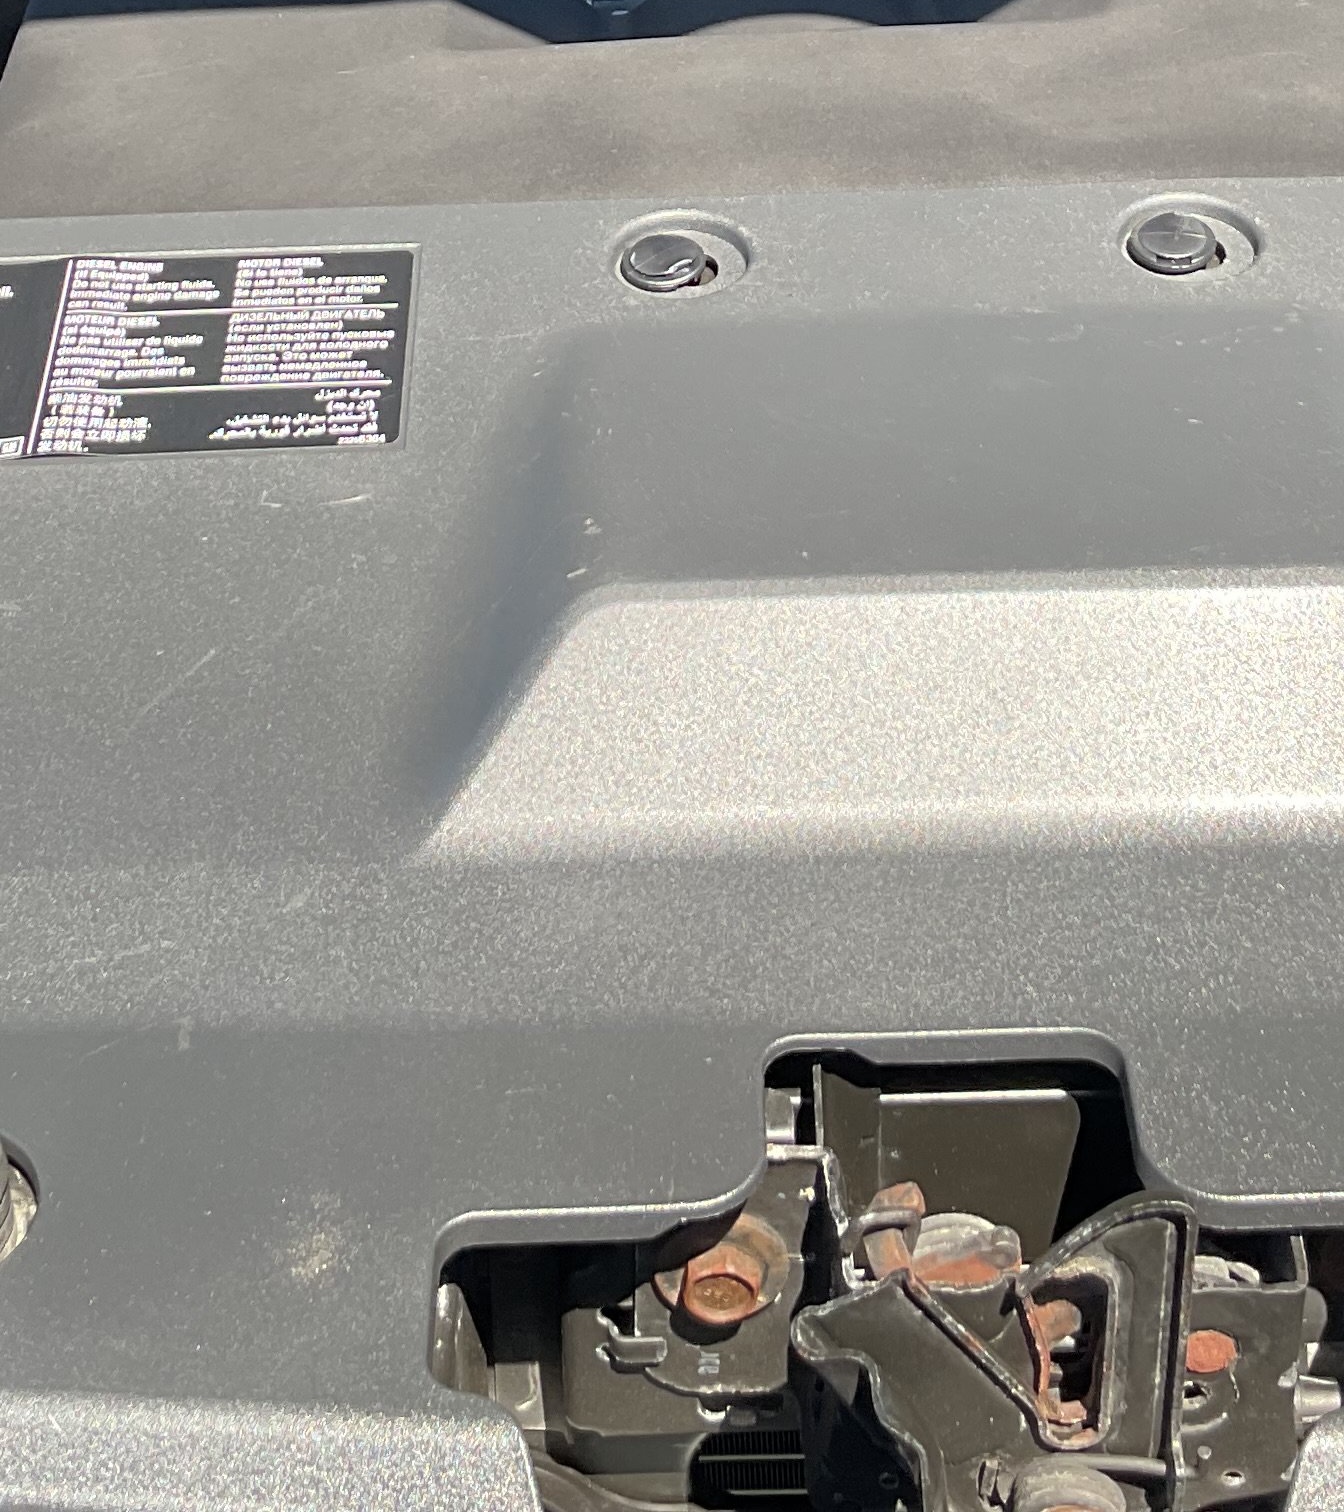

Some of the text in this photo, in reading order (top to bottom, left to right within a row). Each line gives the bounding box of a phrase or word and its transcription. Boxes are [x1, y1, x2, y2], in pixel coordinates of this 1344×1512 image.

[76, 259, 164, 273] DIESEL ENGINE
[237, 257, 324, 268] MOTOR DIESEL
[72, 280, 88, 289] Do
[90, 280, 110, 289] not
[111, 282, 133, 291] use
[134, 281, 179, 292] starting
[235, 278, 252, 288] No
[254, 279, 275, 287] use
[277, 276, 315, 286] fluidos
[317, 276, 332, 285] de
[132, 291, 172, 302] engine
[173, 290, 220, 301] damage
[234, 288, 250, 297] Se
[251, 287, 294, 298] pueden
[295, 285, 344, 297] producir
[67, 301, 89, 309] can
[297, 296, 312, 304] en
[314, 296, 326, 304] el
[64, 315, 161, 328] MOTEUR DIESEL
[229, 309, 386, 323] ДИЗЕЛЬНЫЙ ДВИГАТЕЛЬ
[78, 337, 101, 346] pas
[247, 331, 330, 343] используйте
[331, 330, 395, 340] пусковые
[225, 340, 389, 353] жидкости для холодного
[281, 351, 307, 361] Это
[309, 350, 353, 360] может
[55, 356, 121, 368] dommages
[222, 362, 277, 373] вызвать
[53, 368, 69, 377] au
[71, 368, 115, 378] moteur
[179, 366, 196, 376] en
